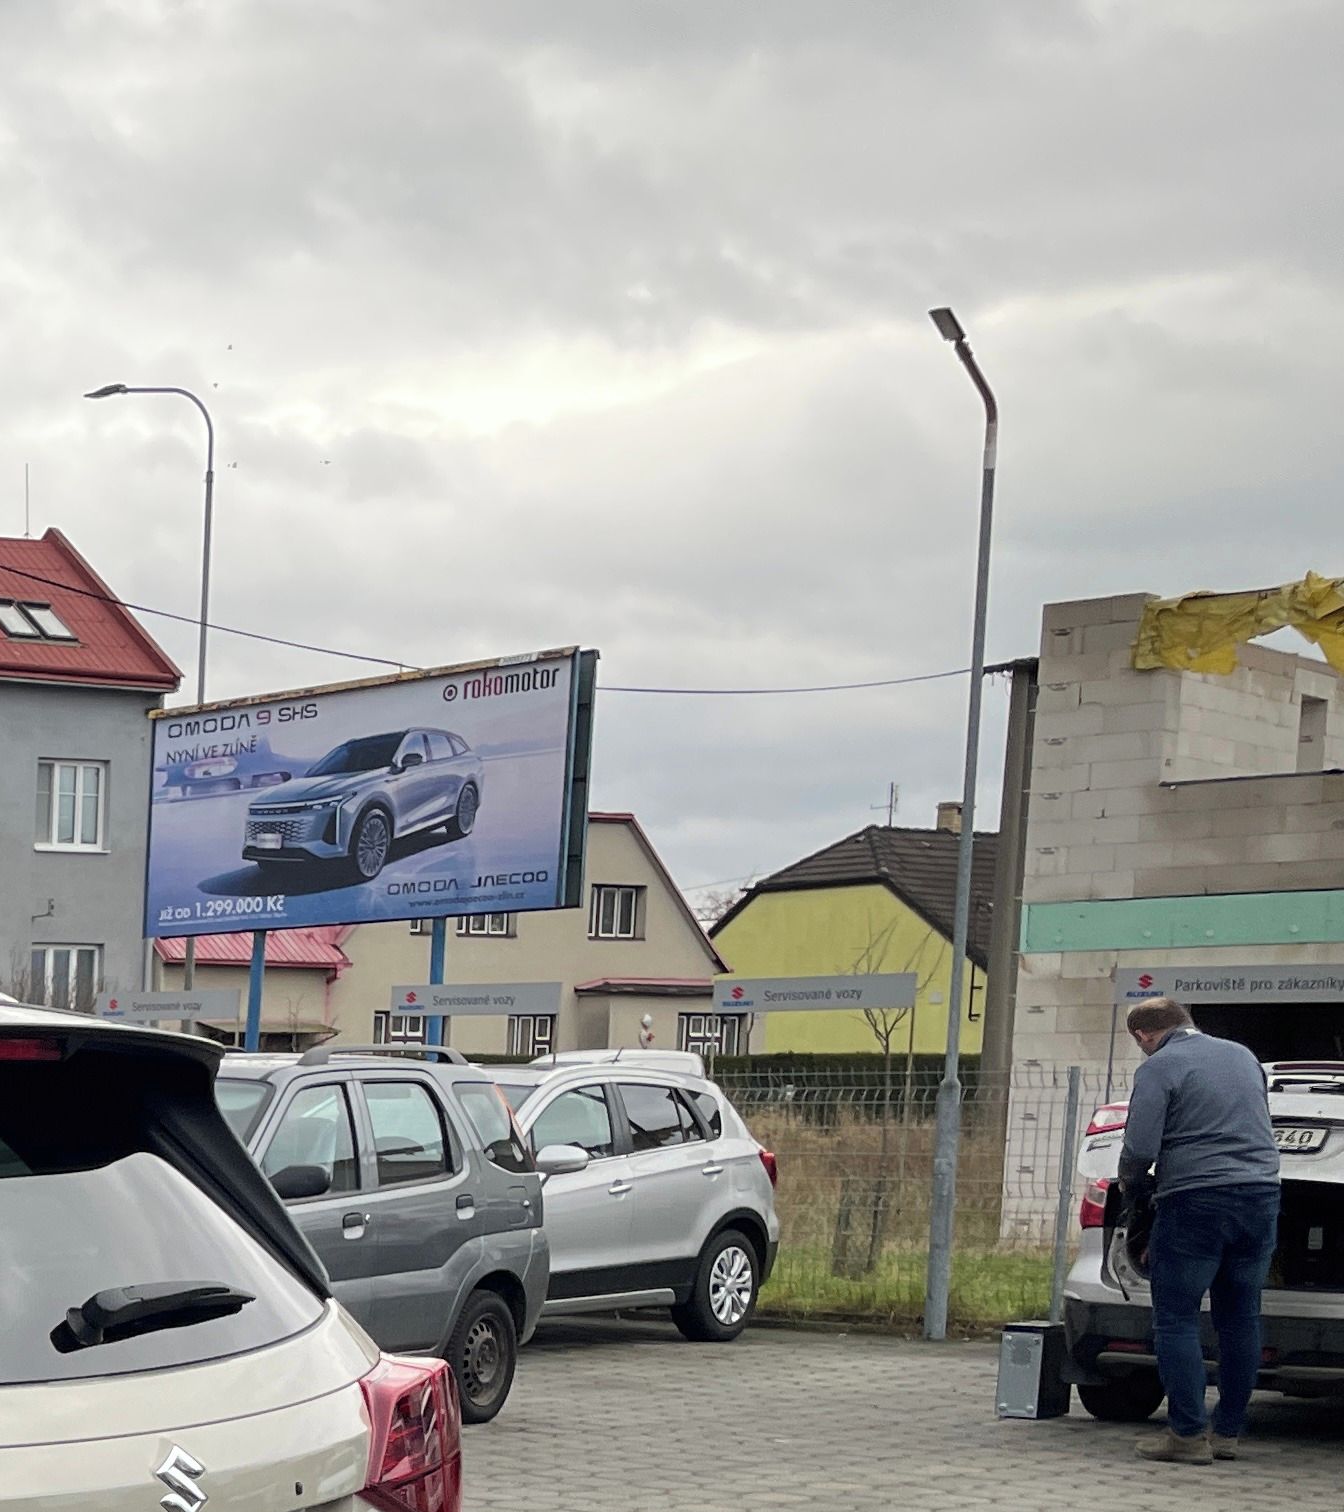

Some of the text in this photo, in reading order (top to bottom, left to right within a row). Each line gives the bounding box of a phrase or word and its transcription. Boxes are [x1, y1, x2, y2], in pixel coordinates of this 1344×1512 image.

[463, 668, 560, 700] rokomotor
[256, 709, 272, 726] 9
[277, 703, 318, 723] SHS
[166, 735, 258, 765] NYNÍ VE ZLÍNĚ
[175, 907, 191, 919] OD
[195, 897, 263, 918] 1.299.000
[267, 894, 285, 912] Kč
[763, 988, 863, 1002] Servisované vozy
[1174, 976, 1344, 993] Parkoviště pro zákazníky
[432, 995, 516, 1007] Servisované vozy
